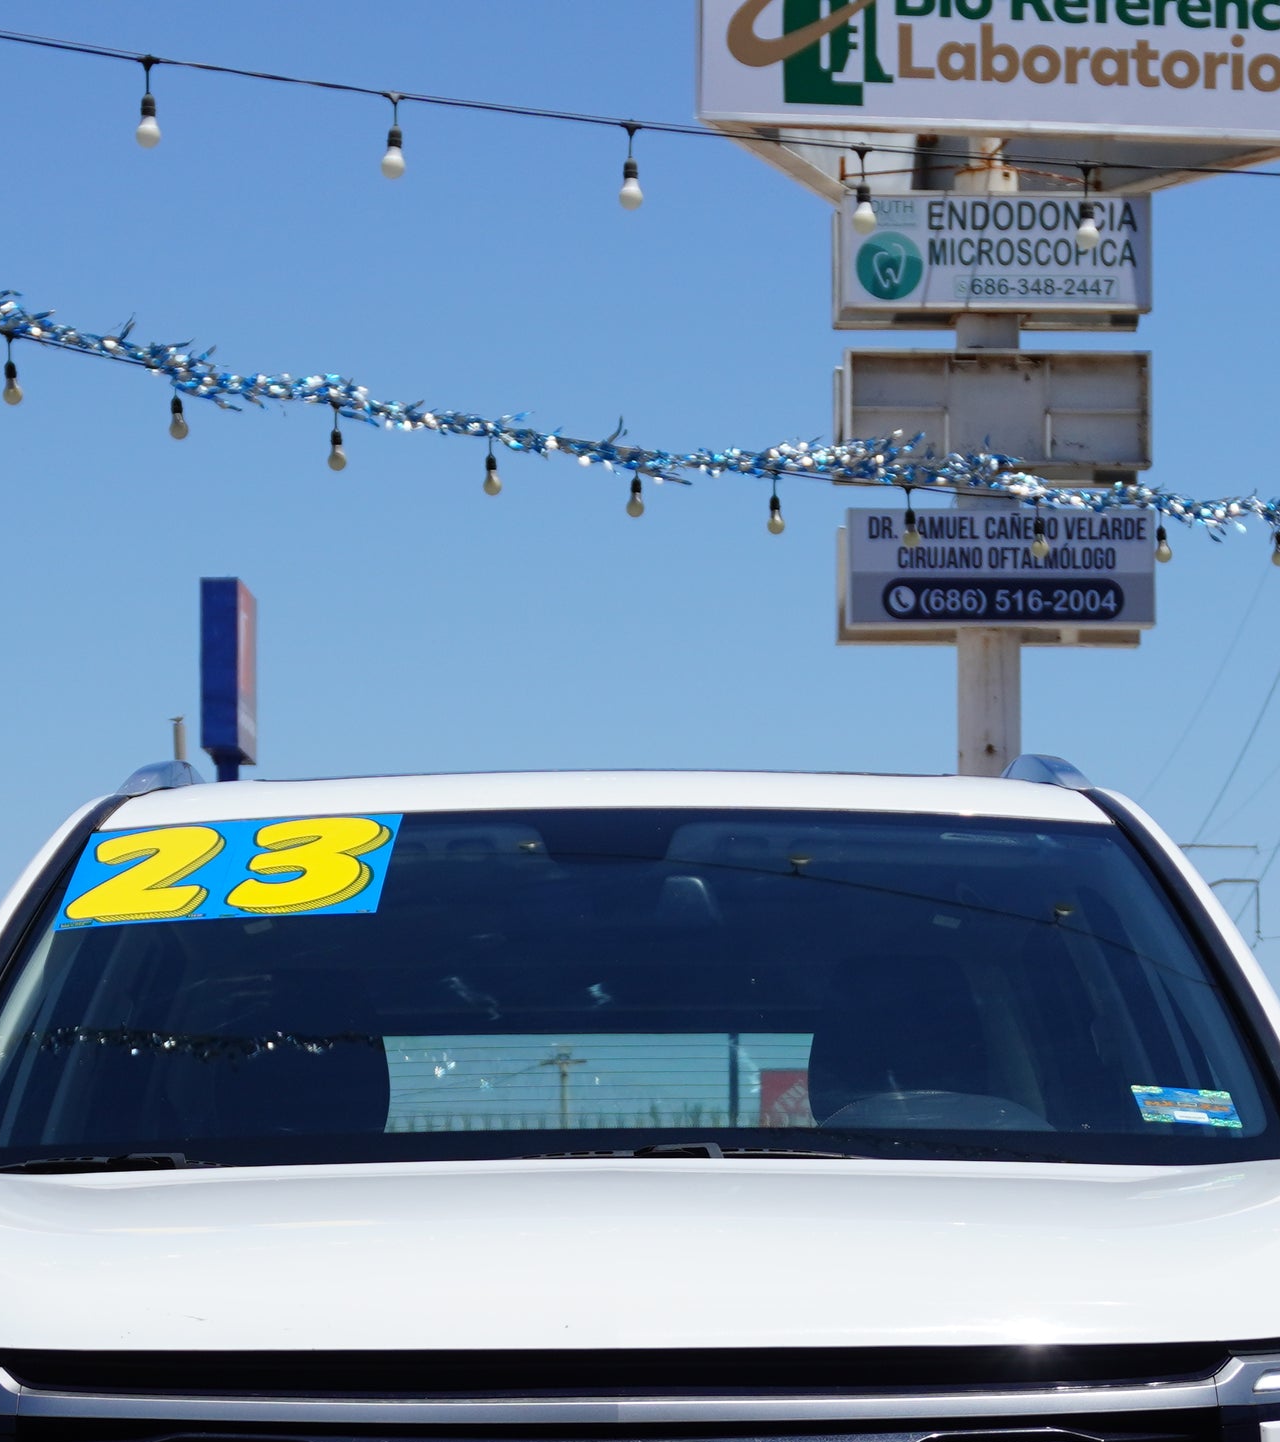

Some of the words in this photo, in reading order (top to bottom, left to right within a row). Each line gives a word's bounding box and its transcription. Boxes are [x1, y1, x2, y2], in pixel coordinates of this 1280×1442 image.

[927, 200, 1139, 232] ENDODONCIA
[970, 277, 1116, 297] 686-348-2447
[867, 515, 898, 540] DR.
[910, 516, 979, 540] AMUEL
[984, 512, 1058, 541] CAÑEO
[1063, 517, 1148, 540] VELARDE
[897, 546, 982, 570] CIRUJANO
[987, 542, 1117, 570] OFTALMÓLOGO
[920, 588, 988, 614] (686)
[995, 589, 1118, 613] 516-2004
[65, 817, 392, 923] 23
